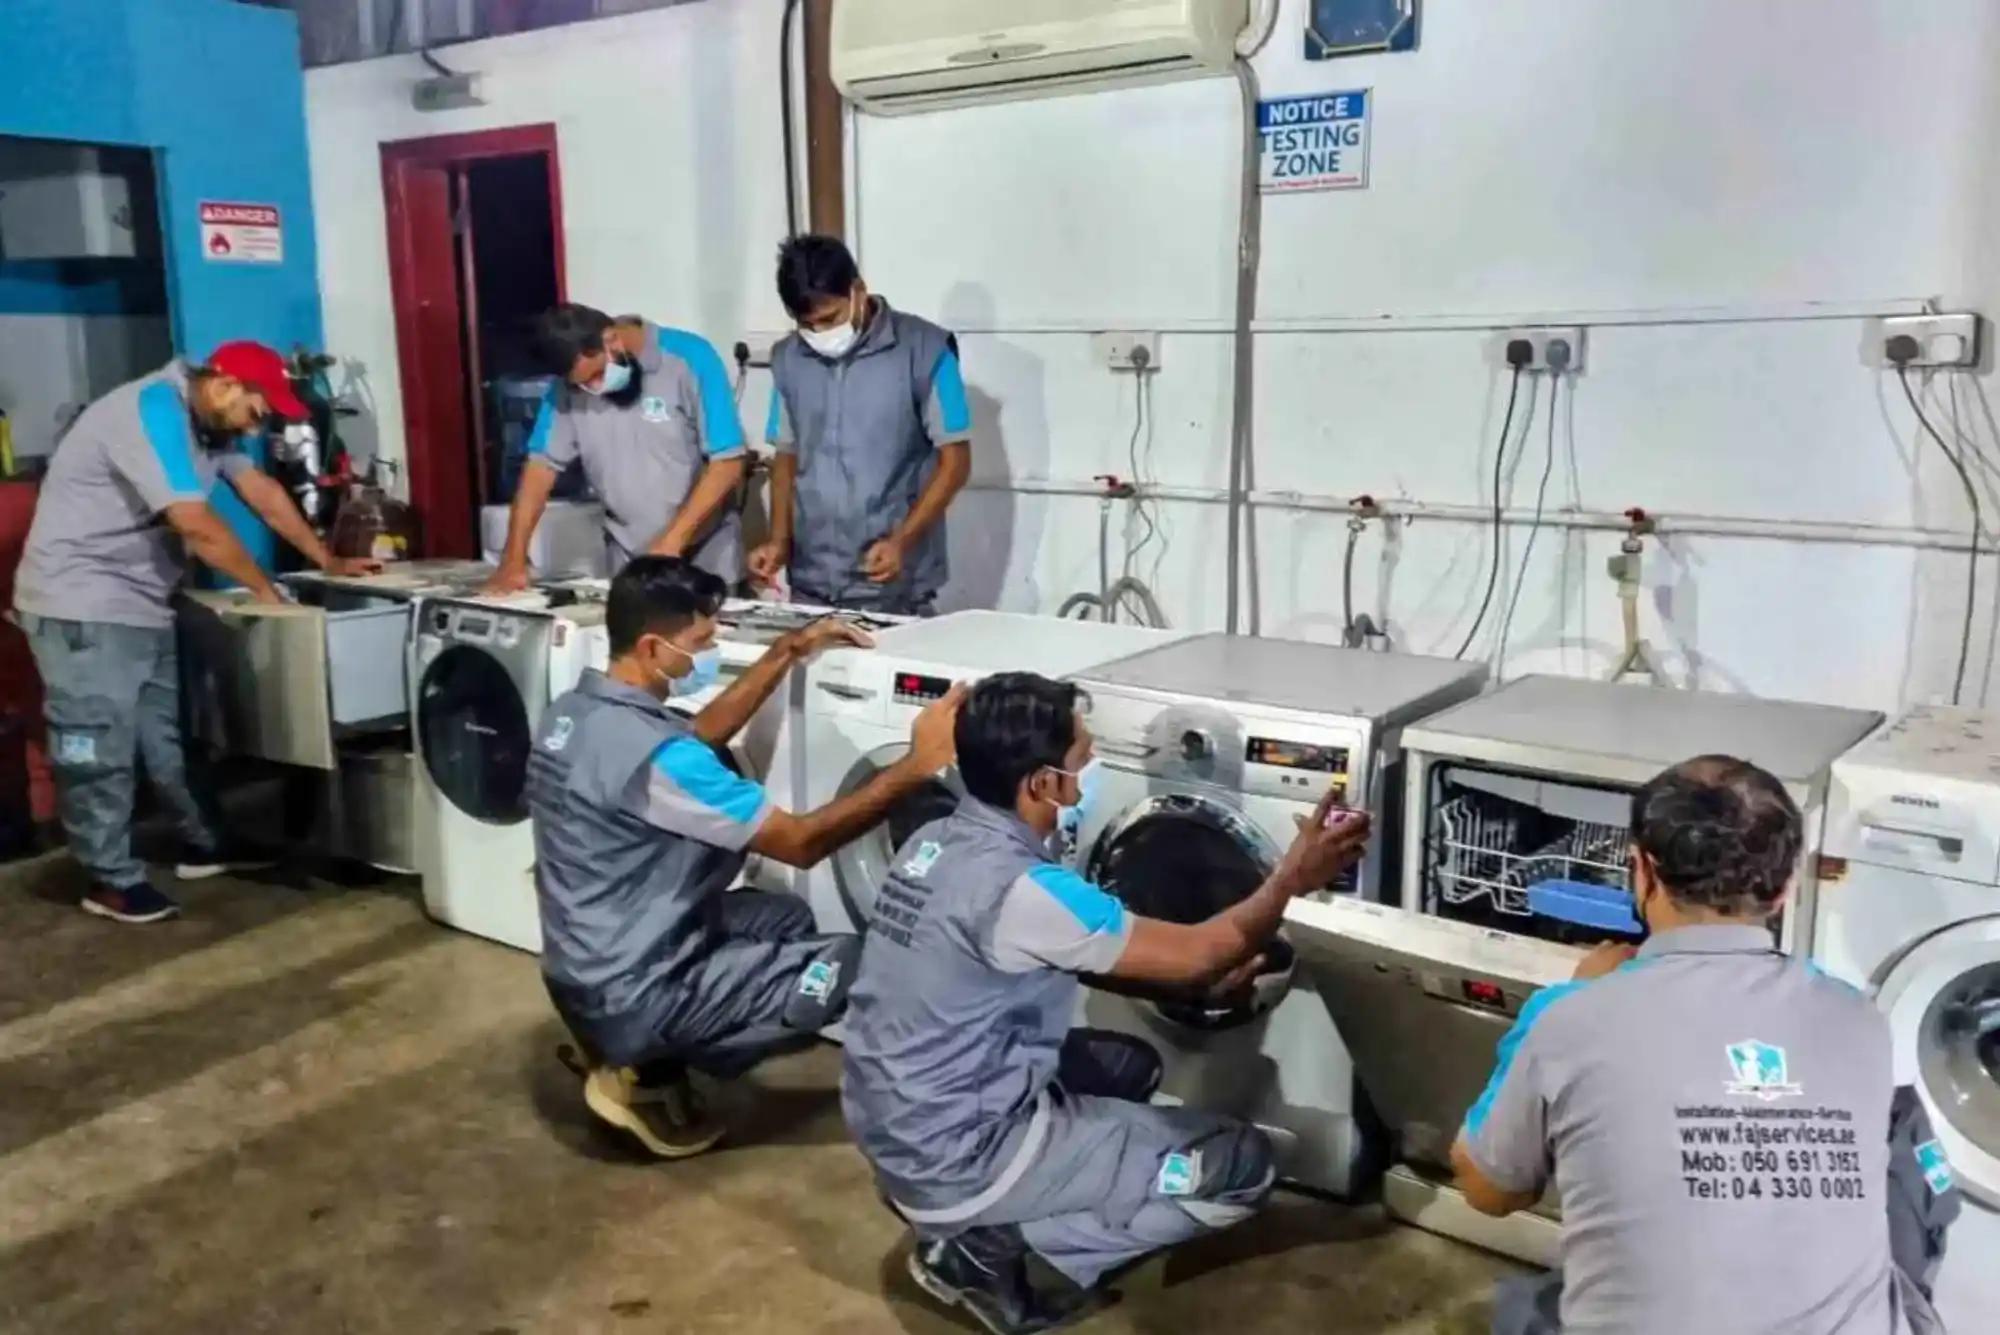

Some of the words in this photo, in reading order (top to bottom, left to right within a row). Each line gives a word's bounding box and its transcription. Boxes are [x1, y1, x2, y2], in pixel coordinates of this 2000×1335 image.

[1268, 97, 1350, 124] NOTICE
[1272, 151, 1341, 177] ZONE
[1742, 1151, 1778, 1172] 050
[1786, 1150, 1821, 1172] 691
[1771, 1177, 1812, 1199] 330
[1820, 1177, 1865, 1199] 0002
